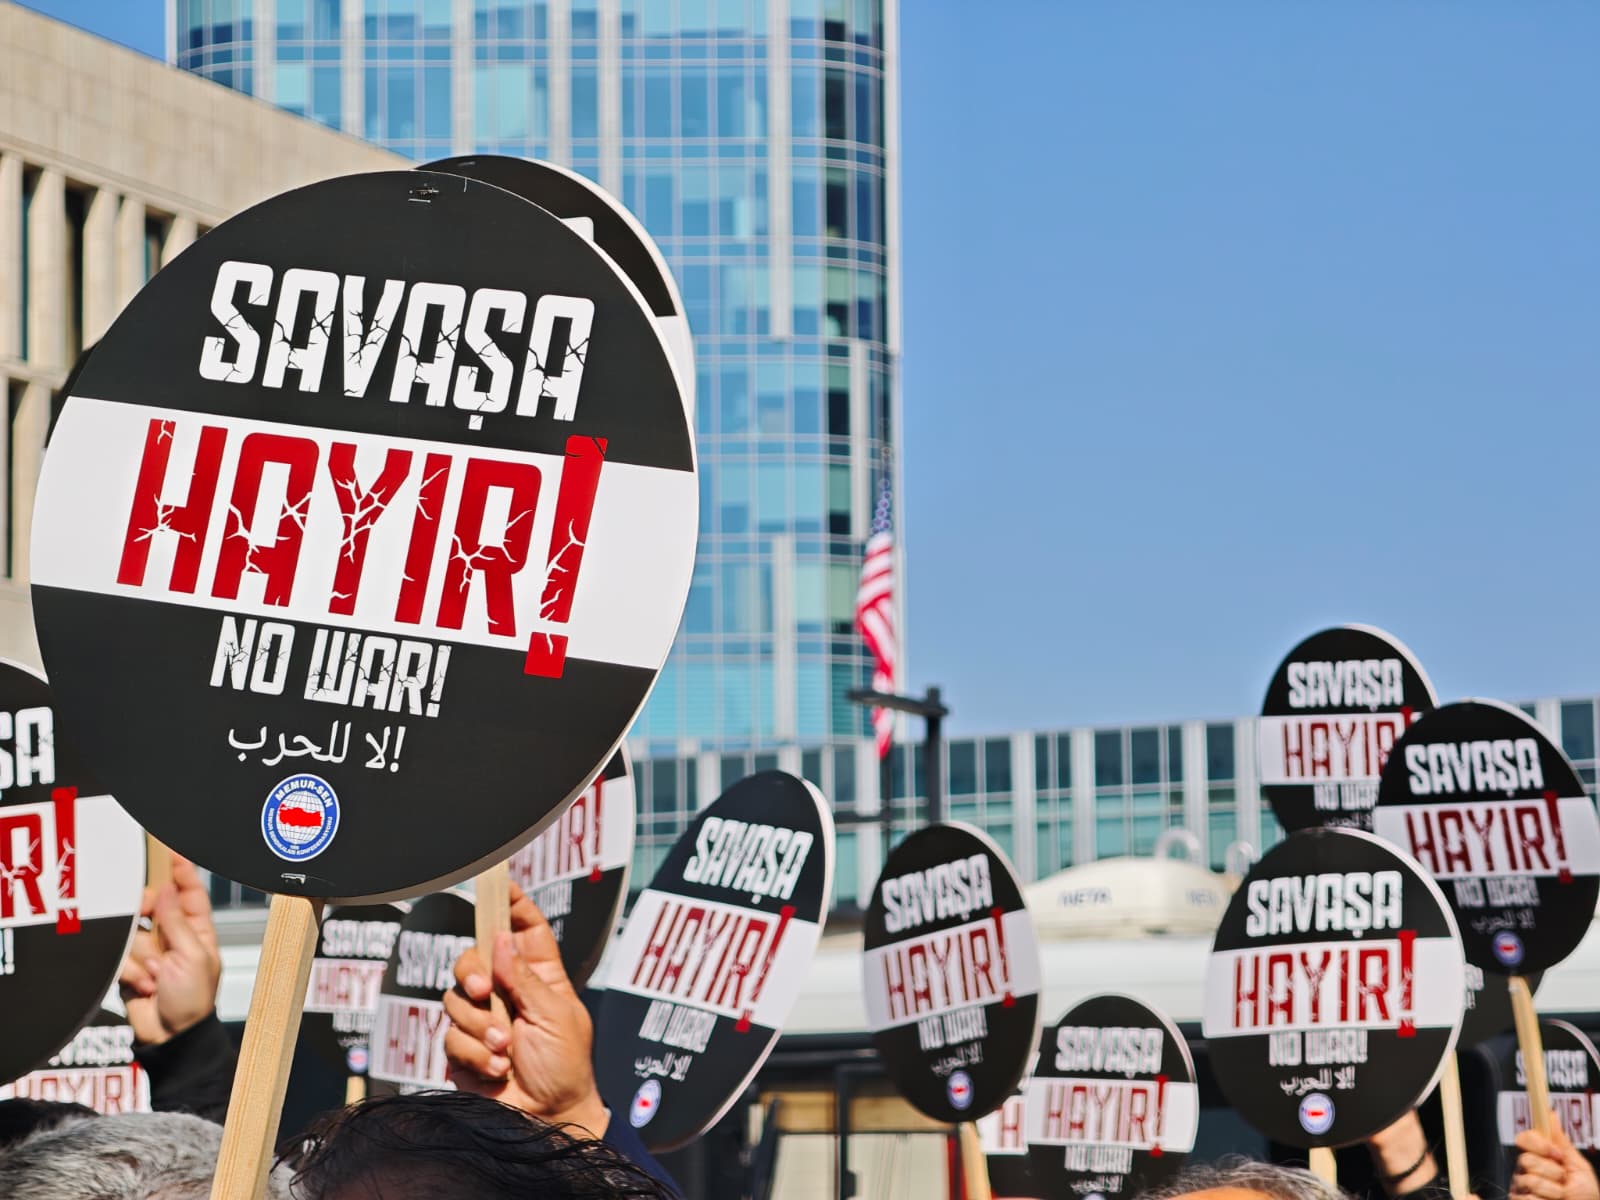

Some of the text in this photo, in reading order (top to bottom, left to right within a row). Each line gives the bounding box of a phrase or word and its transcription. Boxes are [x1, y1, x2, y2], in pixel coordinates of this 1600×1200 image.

[199, 260, 595, 430] SAVAŞA
[117, 418, 608, 679] HAYIR!
[209, 615, 452, 718] NO WAR!
[1287, 659, 1403, 711] SAVAŞA
[228, 720, 352, 767] للحرب
[1283, 706, 1413, 777] HAYIR
[1405, 738, 1544, 798] SAVAŞA
[275, 779, 334, 808] MEMUR-SEN
[683, 816, 814, 904] SAVAŞA
[1406, 791, 1574, 883] HAYIR!
[882, 853, 994, 933] SAVAŞA
[1246, 870, 1402, 938] SAVAŞA
[632, 901, 796, 1032] HAYIR!
[882, 906, 1015, 1021] HAYIR!
[1233, 929, 1416, 1037] HAYIR!
[1055, 1026, 1164, 1079] SAVAŞA
[1269, 1029, 1368, 1066] NO WAR!
[1044, 1075, 1170, 1157] HAYIR!
